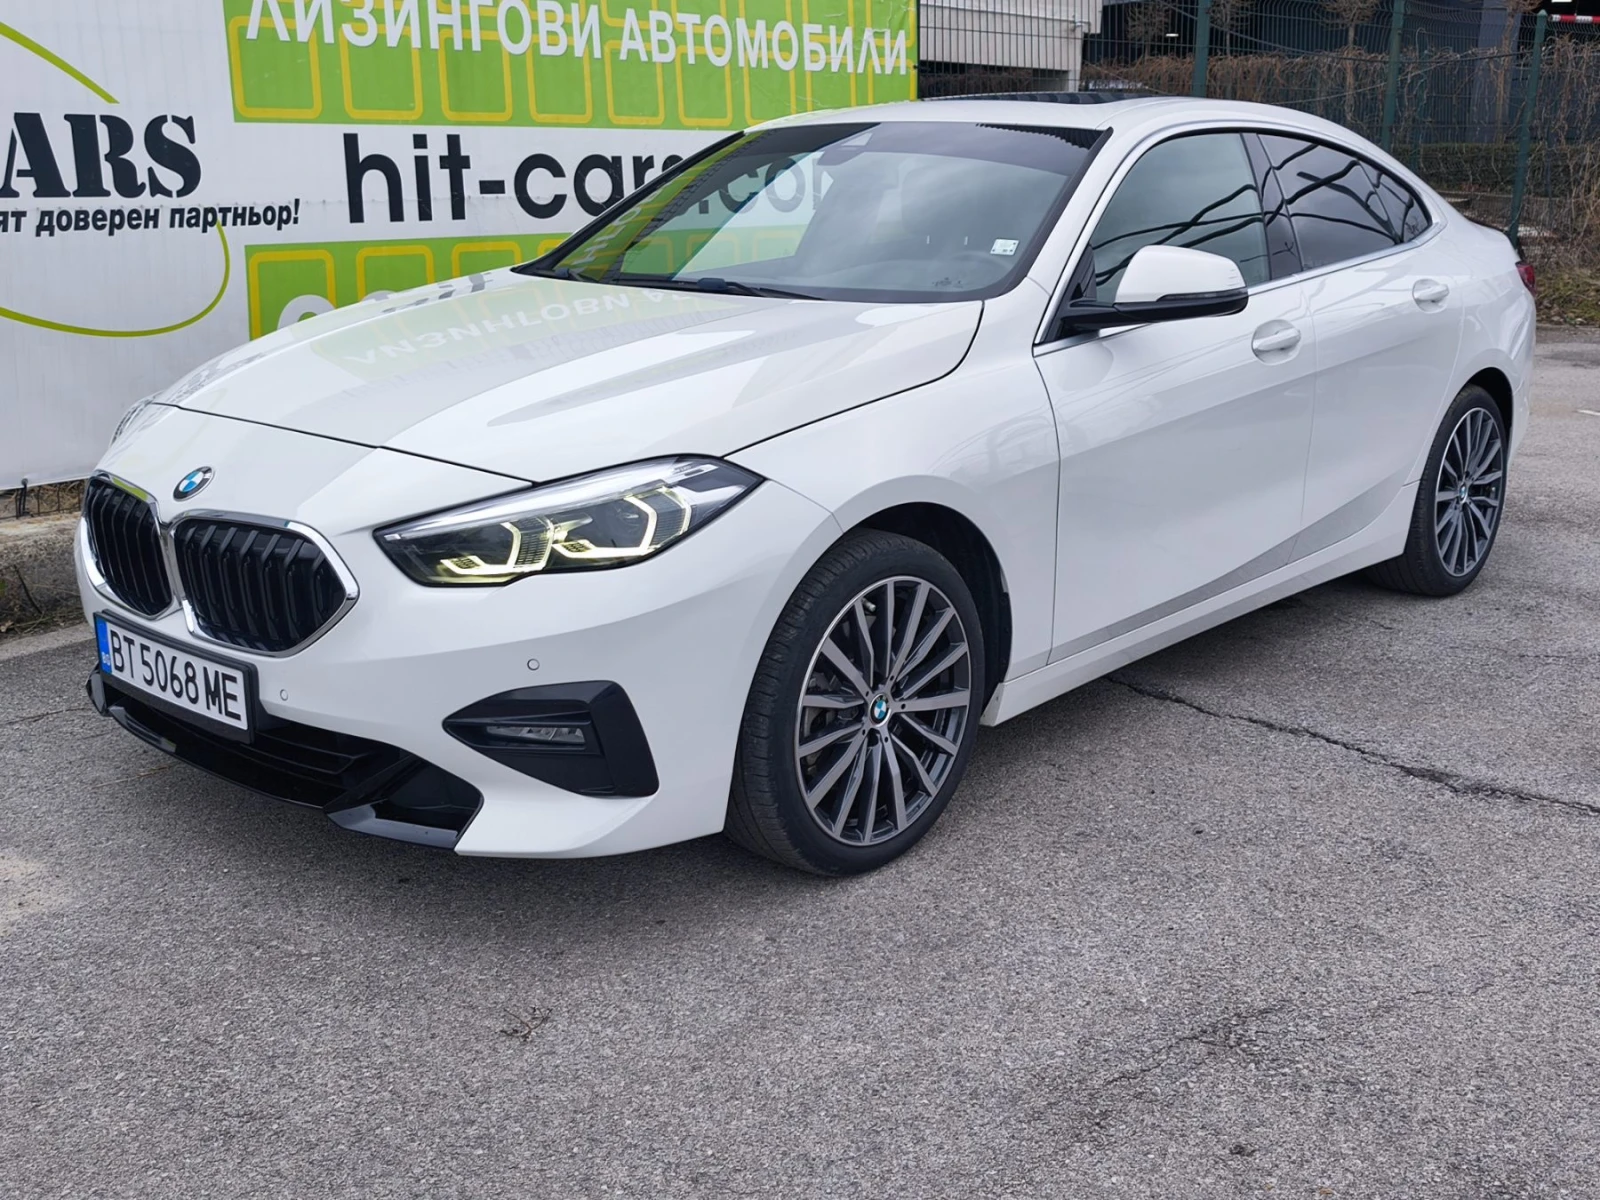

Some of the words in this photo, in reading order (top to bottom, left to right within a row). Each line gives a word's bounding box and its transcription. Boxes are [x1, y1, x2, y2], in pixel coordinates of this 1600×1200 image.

[246, 0, 602, 59] ЛИЗИНГОВИ
[619, 8, 907, 75] АВТОМОБИЛИ
[0, 112, 201, 198] ARS
[35, 207, 160, 237] доверен
[169, 198, 300, 233] партньор!
[110, 629, 135, 679] BT
[140, 642, 200, 705] 5068
[203, 666, 242, 721] ME
